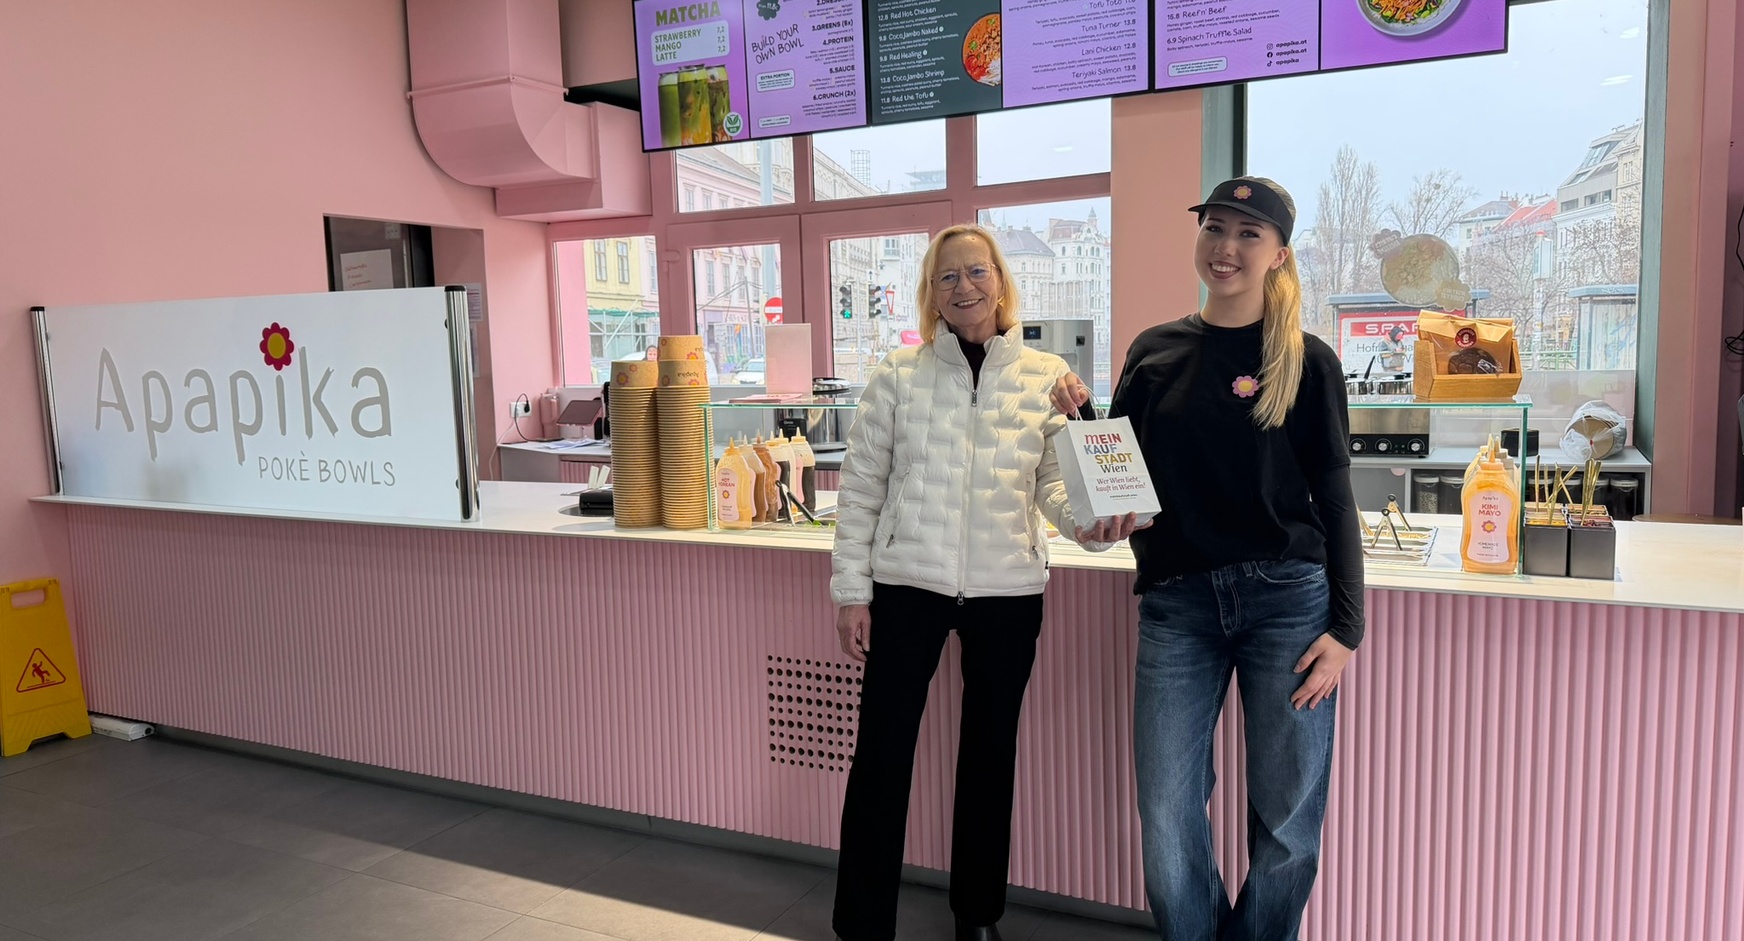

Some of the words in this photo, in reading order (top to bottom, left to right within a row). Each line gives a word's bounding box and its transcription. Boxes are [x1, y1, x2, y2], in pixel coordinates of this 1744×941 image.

[656, 1, 721, 26] MATCHA
[914, 8, 937, 16] Chicken
[1208, 6, 1227, 15] Beef
[812, 21, 840, 31] 3.GREENS
[921, 26, 938, 34] Naked
[1099, 22, 1121, 30] Turner
[655, 29, 701, 43] STRAWBERRY
[776, 24, 799, 40] YOUR
[1178, 34, 1204, 44] Spinach
[1206, 30, 1232, 38] Truffle
[1233, 27, 1252, 35] Salad
[823, 36, 854, 45] 4.PROTEIN
[1276, 40, 1307, 48] apapika.at
[655, 42, 682, 52] MANGO
[756, 47, 776, 64] OWN
[778, 38, 804, 54] BOWL
[1096, 45, 1121, 53] Chicken
[656, 51, 677, 61] LATTE
[901, 51, 922, 59] Healing
[830, 65, 855, 74] 5.SAUCE
[925, 70, 944, 78] Shrimp
[1072, 69, 1097, 79] Teriyaki
[1098, 67, 1121, 75] Salmon
[813, 91, 844, 100] 6.CRUNCH
[96, 322, 392, 465] Apapika
[1084, 444, 1117, 455] KAUF
[1095, 453, 1132, 464] STADT
[258, 450, 309, 481] POKÈ
[318, 459, 396, 486] BOWLS
[1100, 464, 1128, 473] Wien
